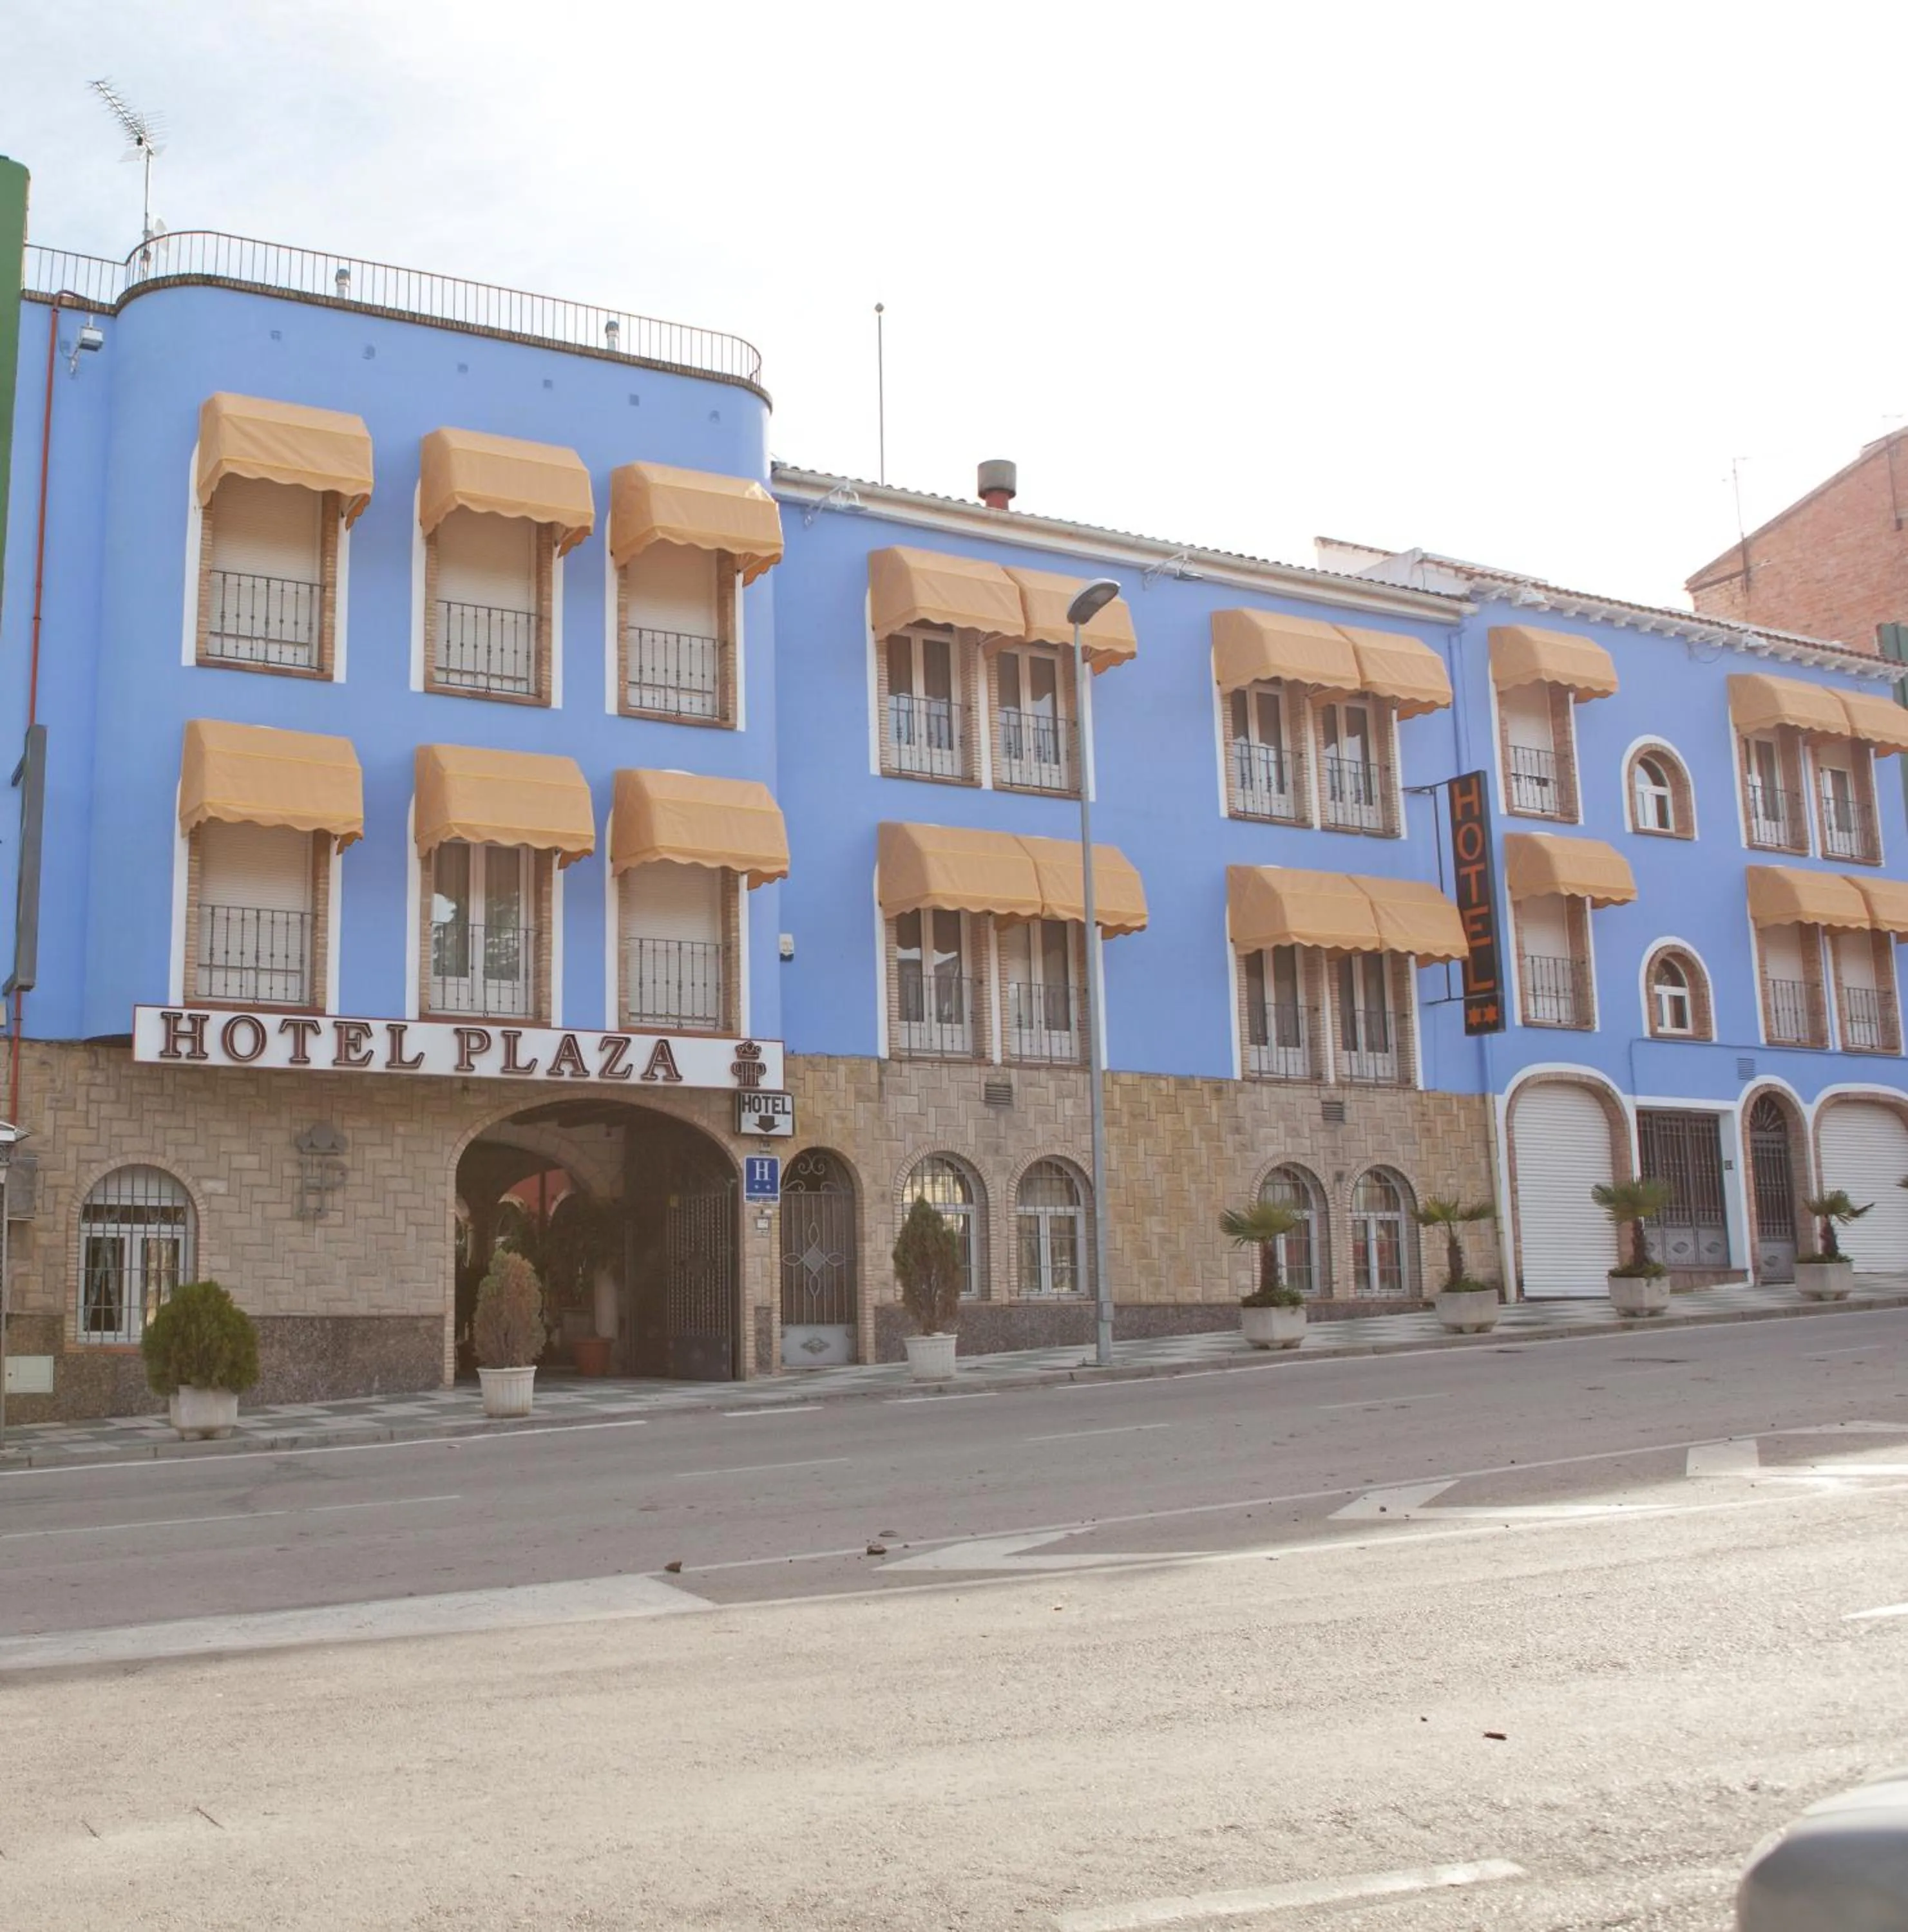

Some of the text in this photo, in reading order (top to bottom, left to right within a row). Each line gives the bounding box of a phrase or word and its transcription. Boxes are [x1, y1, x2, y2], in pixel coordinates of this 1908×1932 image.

[1452, 778, 1494, 990] HOTEL
[159, 1012, 425, 1069] HOTEL
[453, 1028, 683, 1082] PLAZA
[741, 1095, 792, 1115] HOTEL
[753, 1160, 772, 1181] H
